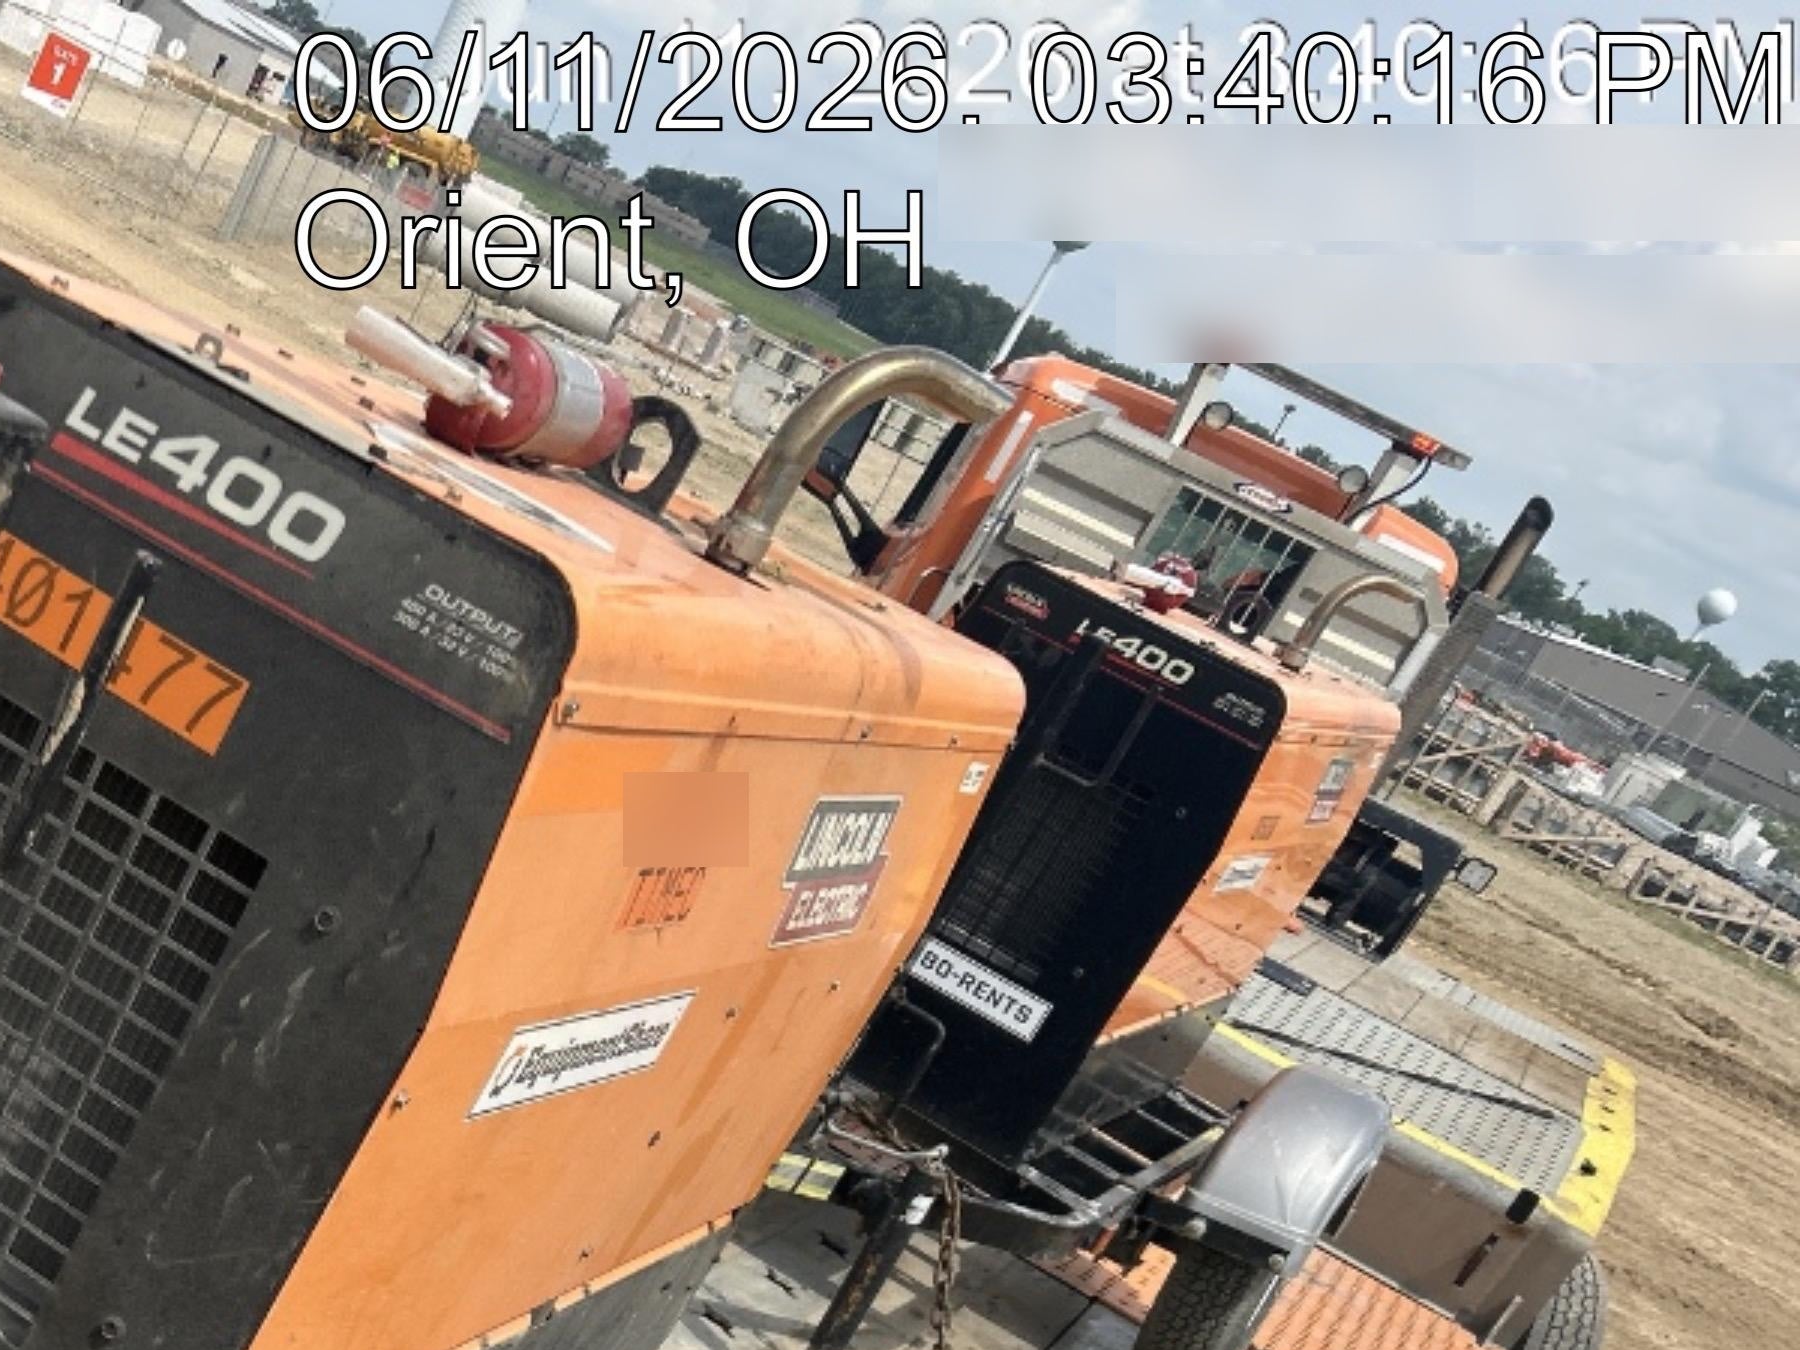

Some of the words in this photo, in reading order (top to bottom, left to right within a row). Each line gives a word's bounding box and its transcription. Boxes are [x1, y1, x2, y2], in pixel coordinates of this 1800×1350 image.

[65, 386, 346, 562] LE400
[425, 584, 522, 643] OUTPUT
[920, 950, 1033, 1024] 80-RENTS
